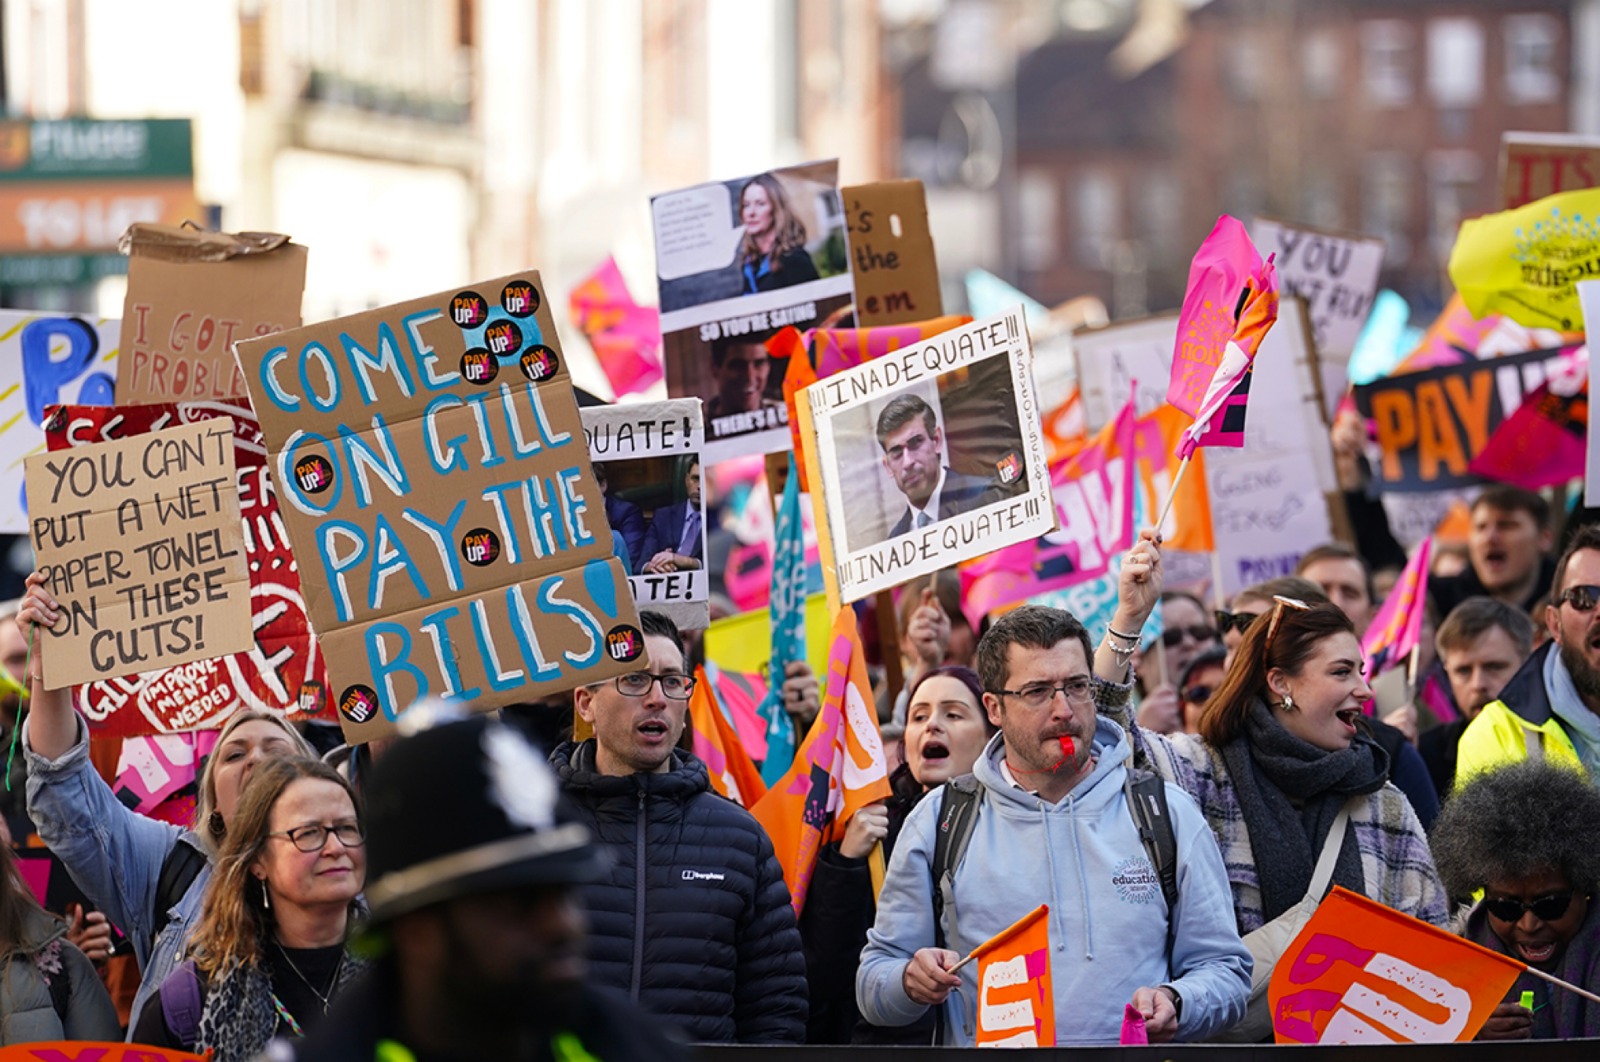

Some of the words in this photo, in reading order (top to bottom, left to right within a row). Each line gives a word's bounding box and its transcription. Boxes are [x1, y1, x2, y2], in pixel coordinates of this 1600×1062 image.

[856, 244, 900, 273] the
[454, 298, 479, 309] PAY
[505, 287, 531, 298] PAY
[134, 305, 151, 346] I
[169, 312, 241, 352] GOT
[487, 325, 511, 339] PAY
[700, 321, 720, 342] SO
[720, 313, 769, 338] YOU'RE
[769, 301, 817, 329] SAYING
[259, 308, 461, 413] COME
[464, 354, 489, 365] PAY
[521, 349, 544, 367] PAY
[1371, 369, 1493, 482] PAY
[45, 452, 135, 503] YOU
[143, 427, 234, 480] CAN'T
[277, 412, 411, 518] ON
[422, 381, 573, 477] GILL
[296, 459, 320, 478] PAY
[34, 510, 92, 551] PUT
[118, 498, 143, 535] A
[155, 477, 228, 526] WET
[314, 499, 467, 623] PAY
[481, 465, 596, 566] THE
[465, 533, 490, 548] PAY
[38, 550, 131, 596] PAPER
[134, 528, 238, 576] TOWEL
[48, 596, 98, 638] ON
[116, 567, 229, 622] THESE
[628, 573, 694, 601] TE!
[90, 614, 206, 673] CUTS!
[608, 629, 633, 645] PAY
[156, 675, 208, 713] MENT
[168, 683, 231, 730] NEEDED
[1112, 874, 1158, 886] educatio
